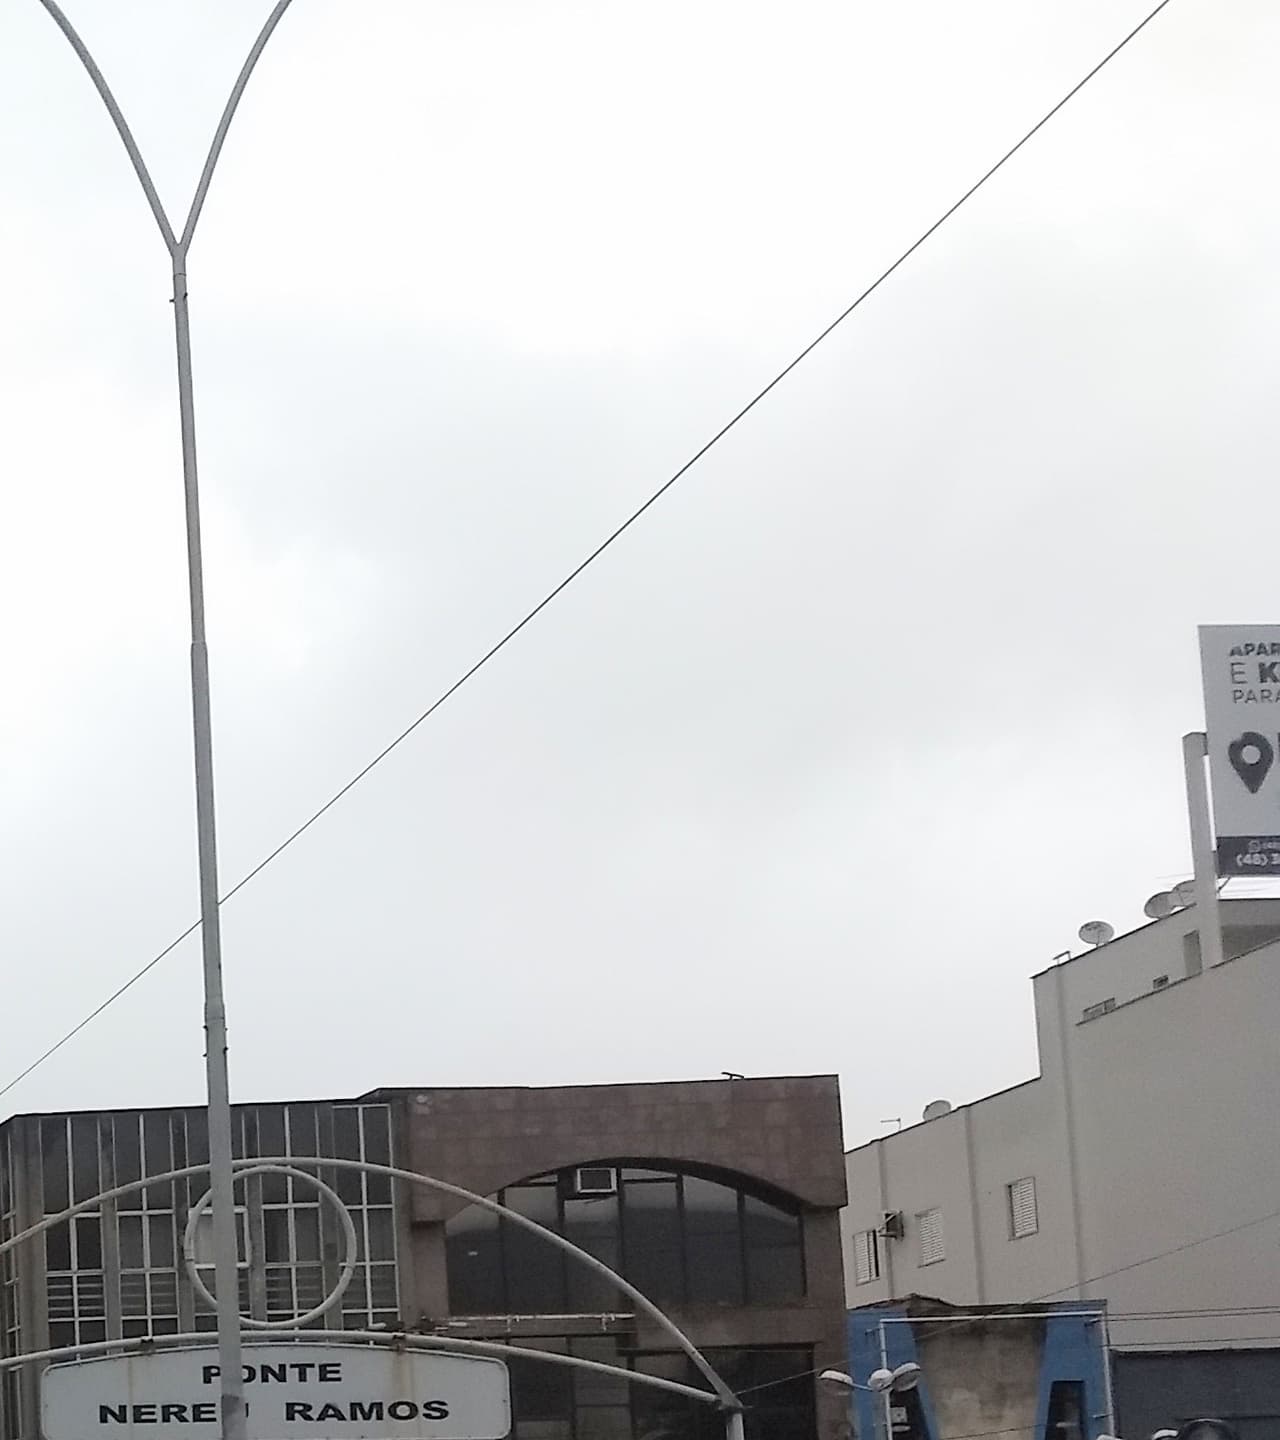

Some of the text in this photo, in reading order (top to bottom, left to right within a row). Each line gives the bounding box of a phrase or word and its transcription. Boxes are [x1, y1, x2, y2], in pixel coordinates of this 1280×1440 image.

[1230, 662, 1248, 684] E
[98, 1400, 451, 1424] NERE RAMOS
